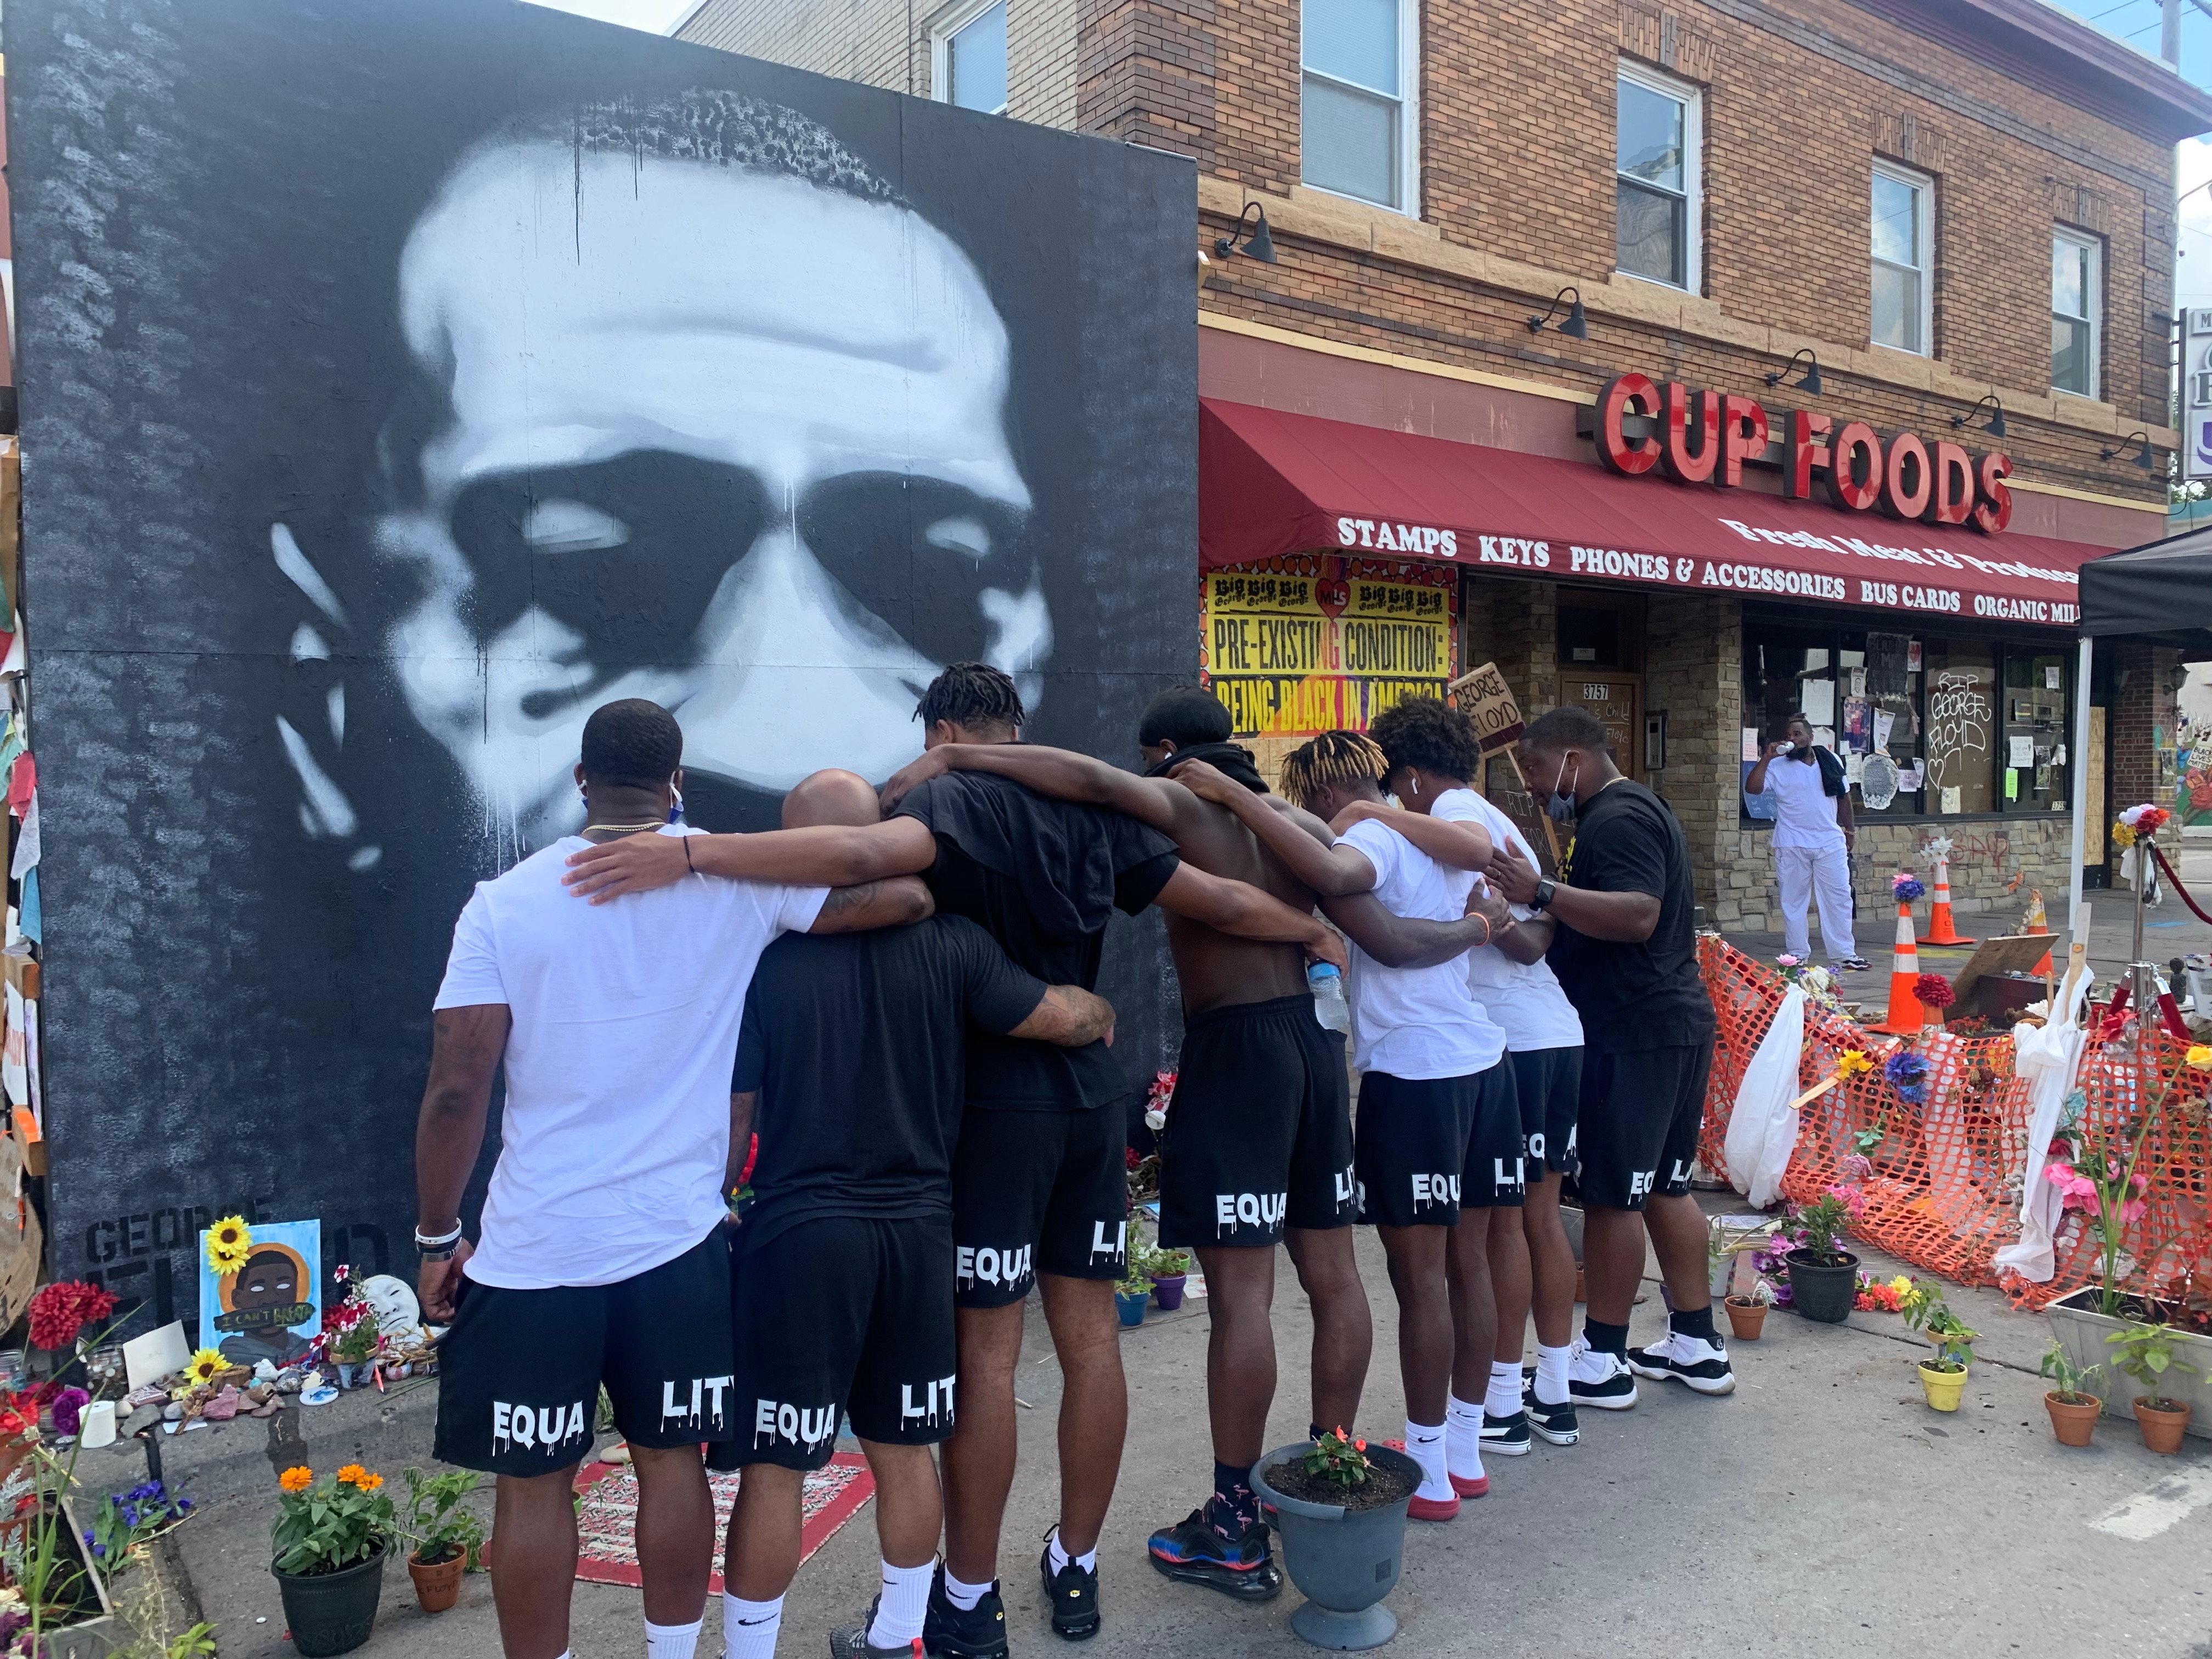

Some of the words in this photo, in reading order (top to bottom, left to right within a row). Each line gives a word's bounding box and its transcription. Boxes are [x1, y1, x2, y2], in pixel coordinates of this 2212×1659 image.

[1594, 372, 1768, 488] CUP
[1784, 409, 2013, 534] FOODS
[1717, 518, 1849, 554] Fresh
[1831, 535, 1936, 566] Meat
[1215, 577, 1245, 596] Big
[1248, 577, 1277, 596] Big
[1279, 580, 1308, 597] Big
[1338, 518, 1458, 557] STAMPS
[1479, 535, 1550, 567] KEYS
[1570, 546, 1669, 580] PHONES
[1675, 558, 1694, 582] &
[1702, 562, 1846, 600] ACCESSORIES
[1861, 580, 1898, 606] BUS
[1902, 585, 1961, 612] CARDS
[1974, 595, 2047, 622] ORGANIC
[2051, 603, 2081, 623] MIL
[1359, 586, 1386, 602] Big
[1389, 588, 1414, 604] Big
[1417, 590, 1443, 607] Big
[1214, 618, 1340, 670] PRE-EXISTING
[1345, 622, 1443, 673] CONDITION:
[1454, 670, 1505, 713] GEORGE
[1584, 684, 1607, 699] 3757
[1938, 672, 1979, 693] RIP
[1216, 680, 1276, 733] BEING
[1280, 679, 1338, 731] BLACK
[1343, 680, 1362, 731] IN
[1932, 692, 1992, 721] GEORGE
[2191, 754, 2211, 763] LIVES
[1506, 793, 1534, 817] RIP
[87, 1198, 273, 1262] GEORE
[1716, 1338, 1724, 1350] 45
[493, 1400, 584, 1457] EQUA
[754, 1398, 836, 1455] EQUA
